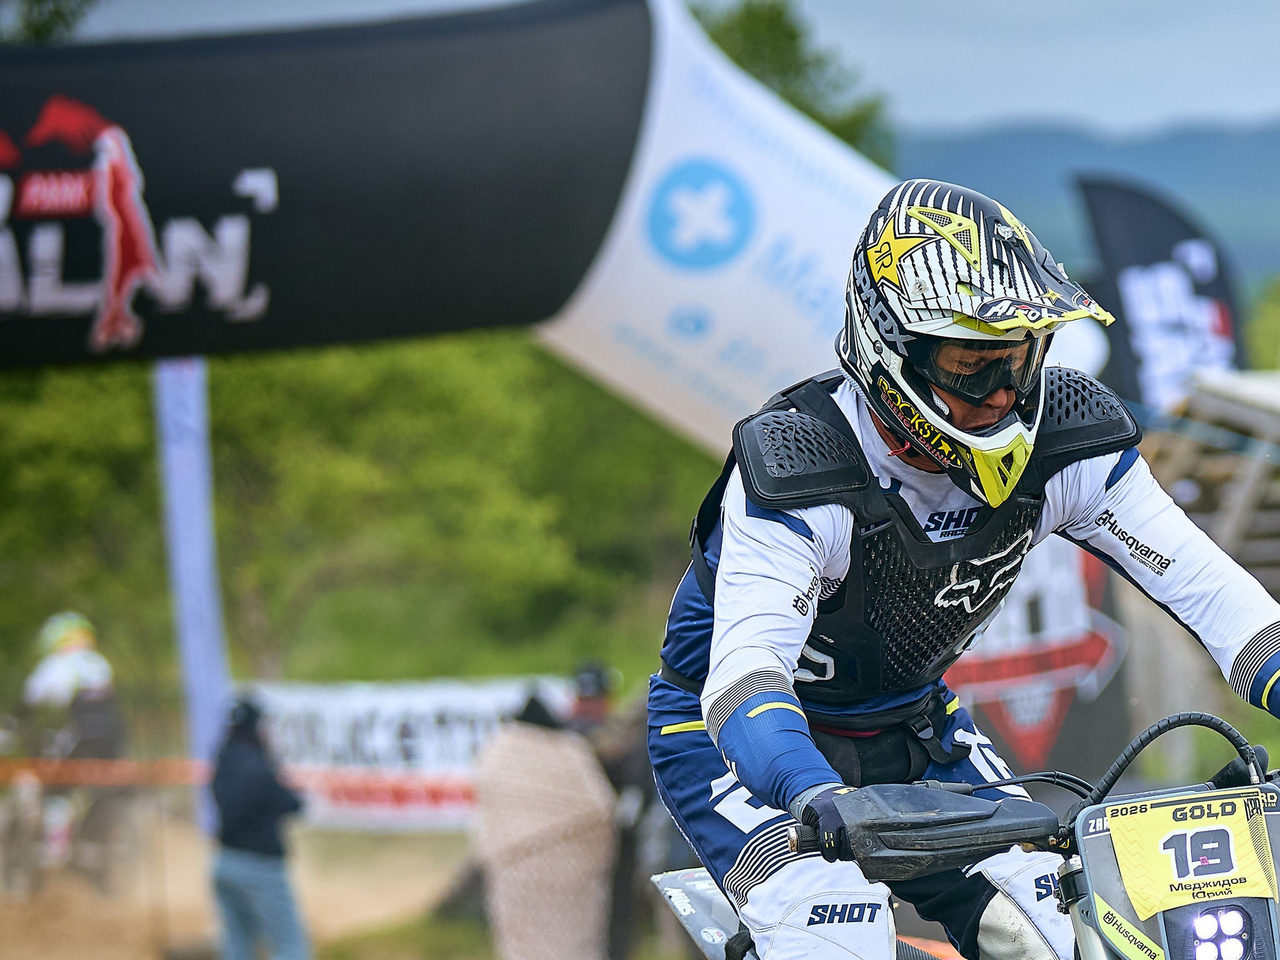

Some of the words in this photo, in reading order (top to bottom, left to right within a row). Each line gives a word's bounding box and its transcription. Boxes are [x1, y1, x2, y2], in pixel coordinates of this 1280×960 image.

[1105, 518, 1172, 570] Husqvarna
[1172, 801, 1237, 823] GOLD
[1162, 828, 1235, 879] 19
[1169, 876, 1248, 893] Меджидов
[1191, 887, 1234, 900] Юрий
[806, 902, 882, 927] SHOT
[1111, 918, 1158, 960] Husqvarna
